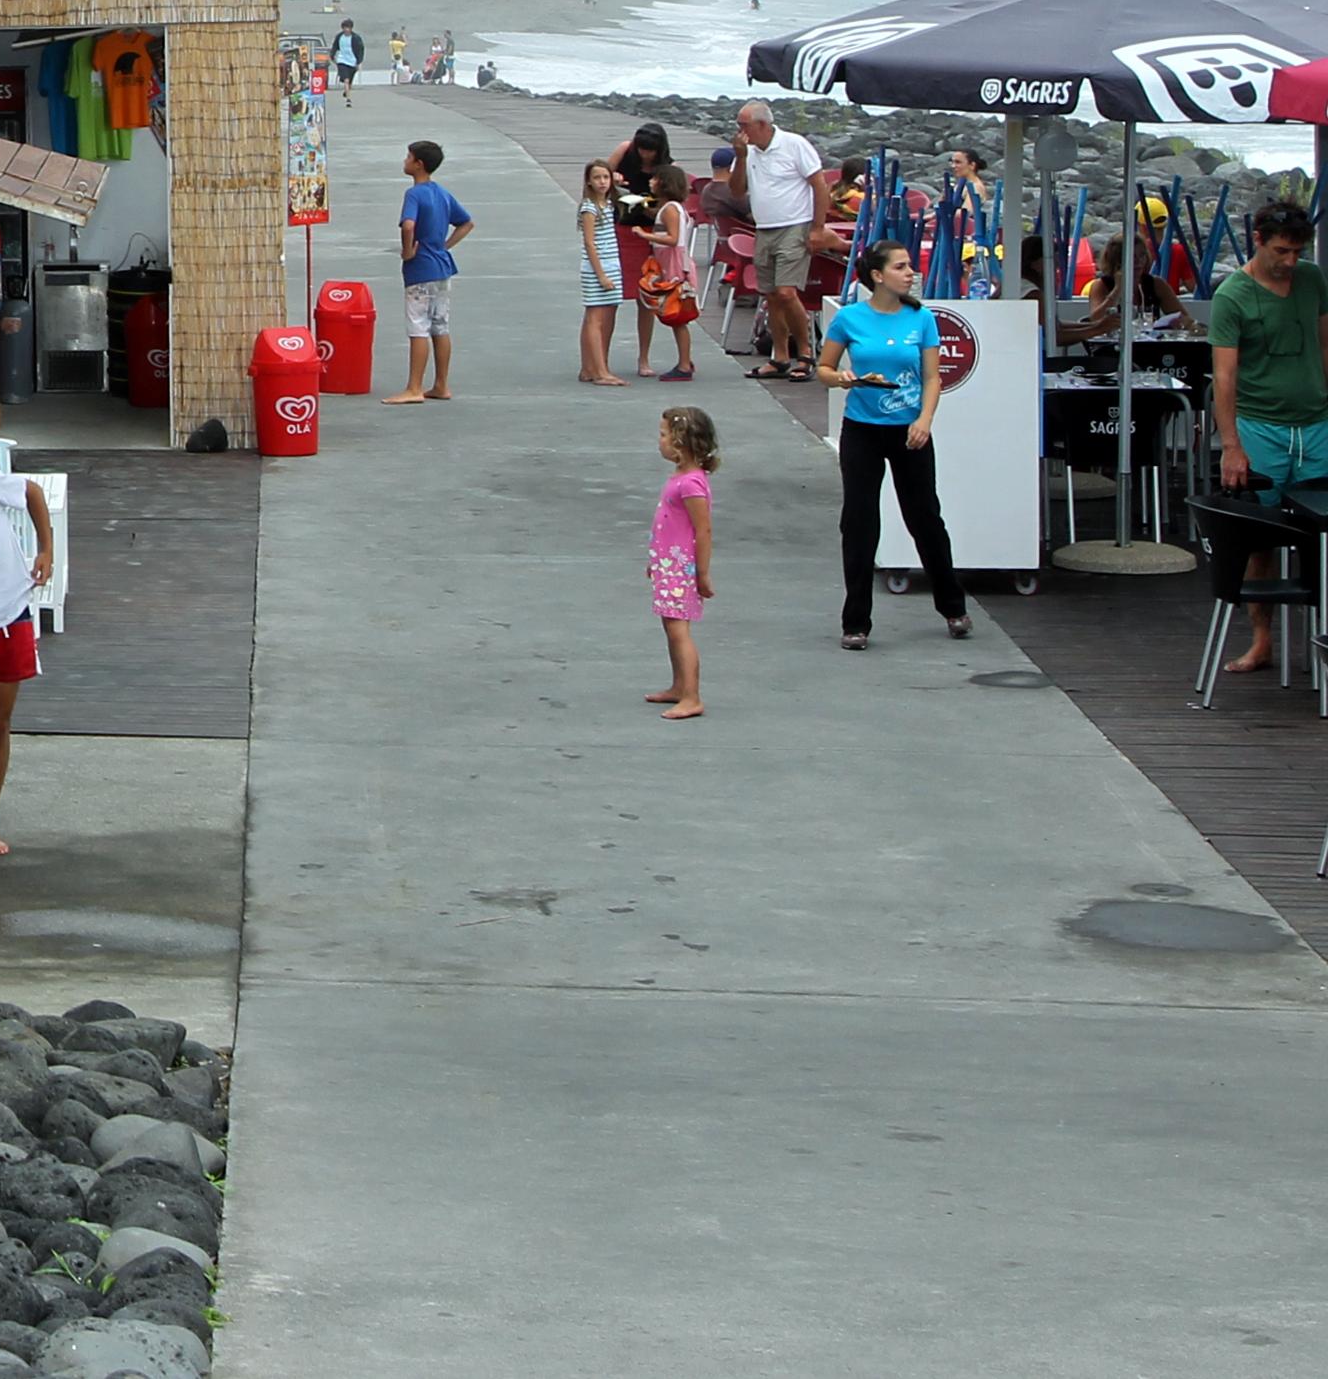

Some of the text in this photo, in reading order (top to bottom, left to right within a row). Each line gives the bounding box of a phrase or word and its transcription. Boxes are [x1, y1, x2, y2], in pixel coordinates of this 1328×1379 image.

[1002, 77, 1073, 105] SAGRES
[938, 345, 965, 358] AL
[286, 420, 312, 435] OLÁ
[1089, 420, 1136, 435] SAGRS
